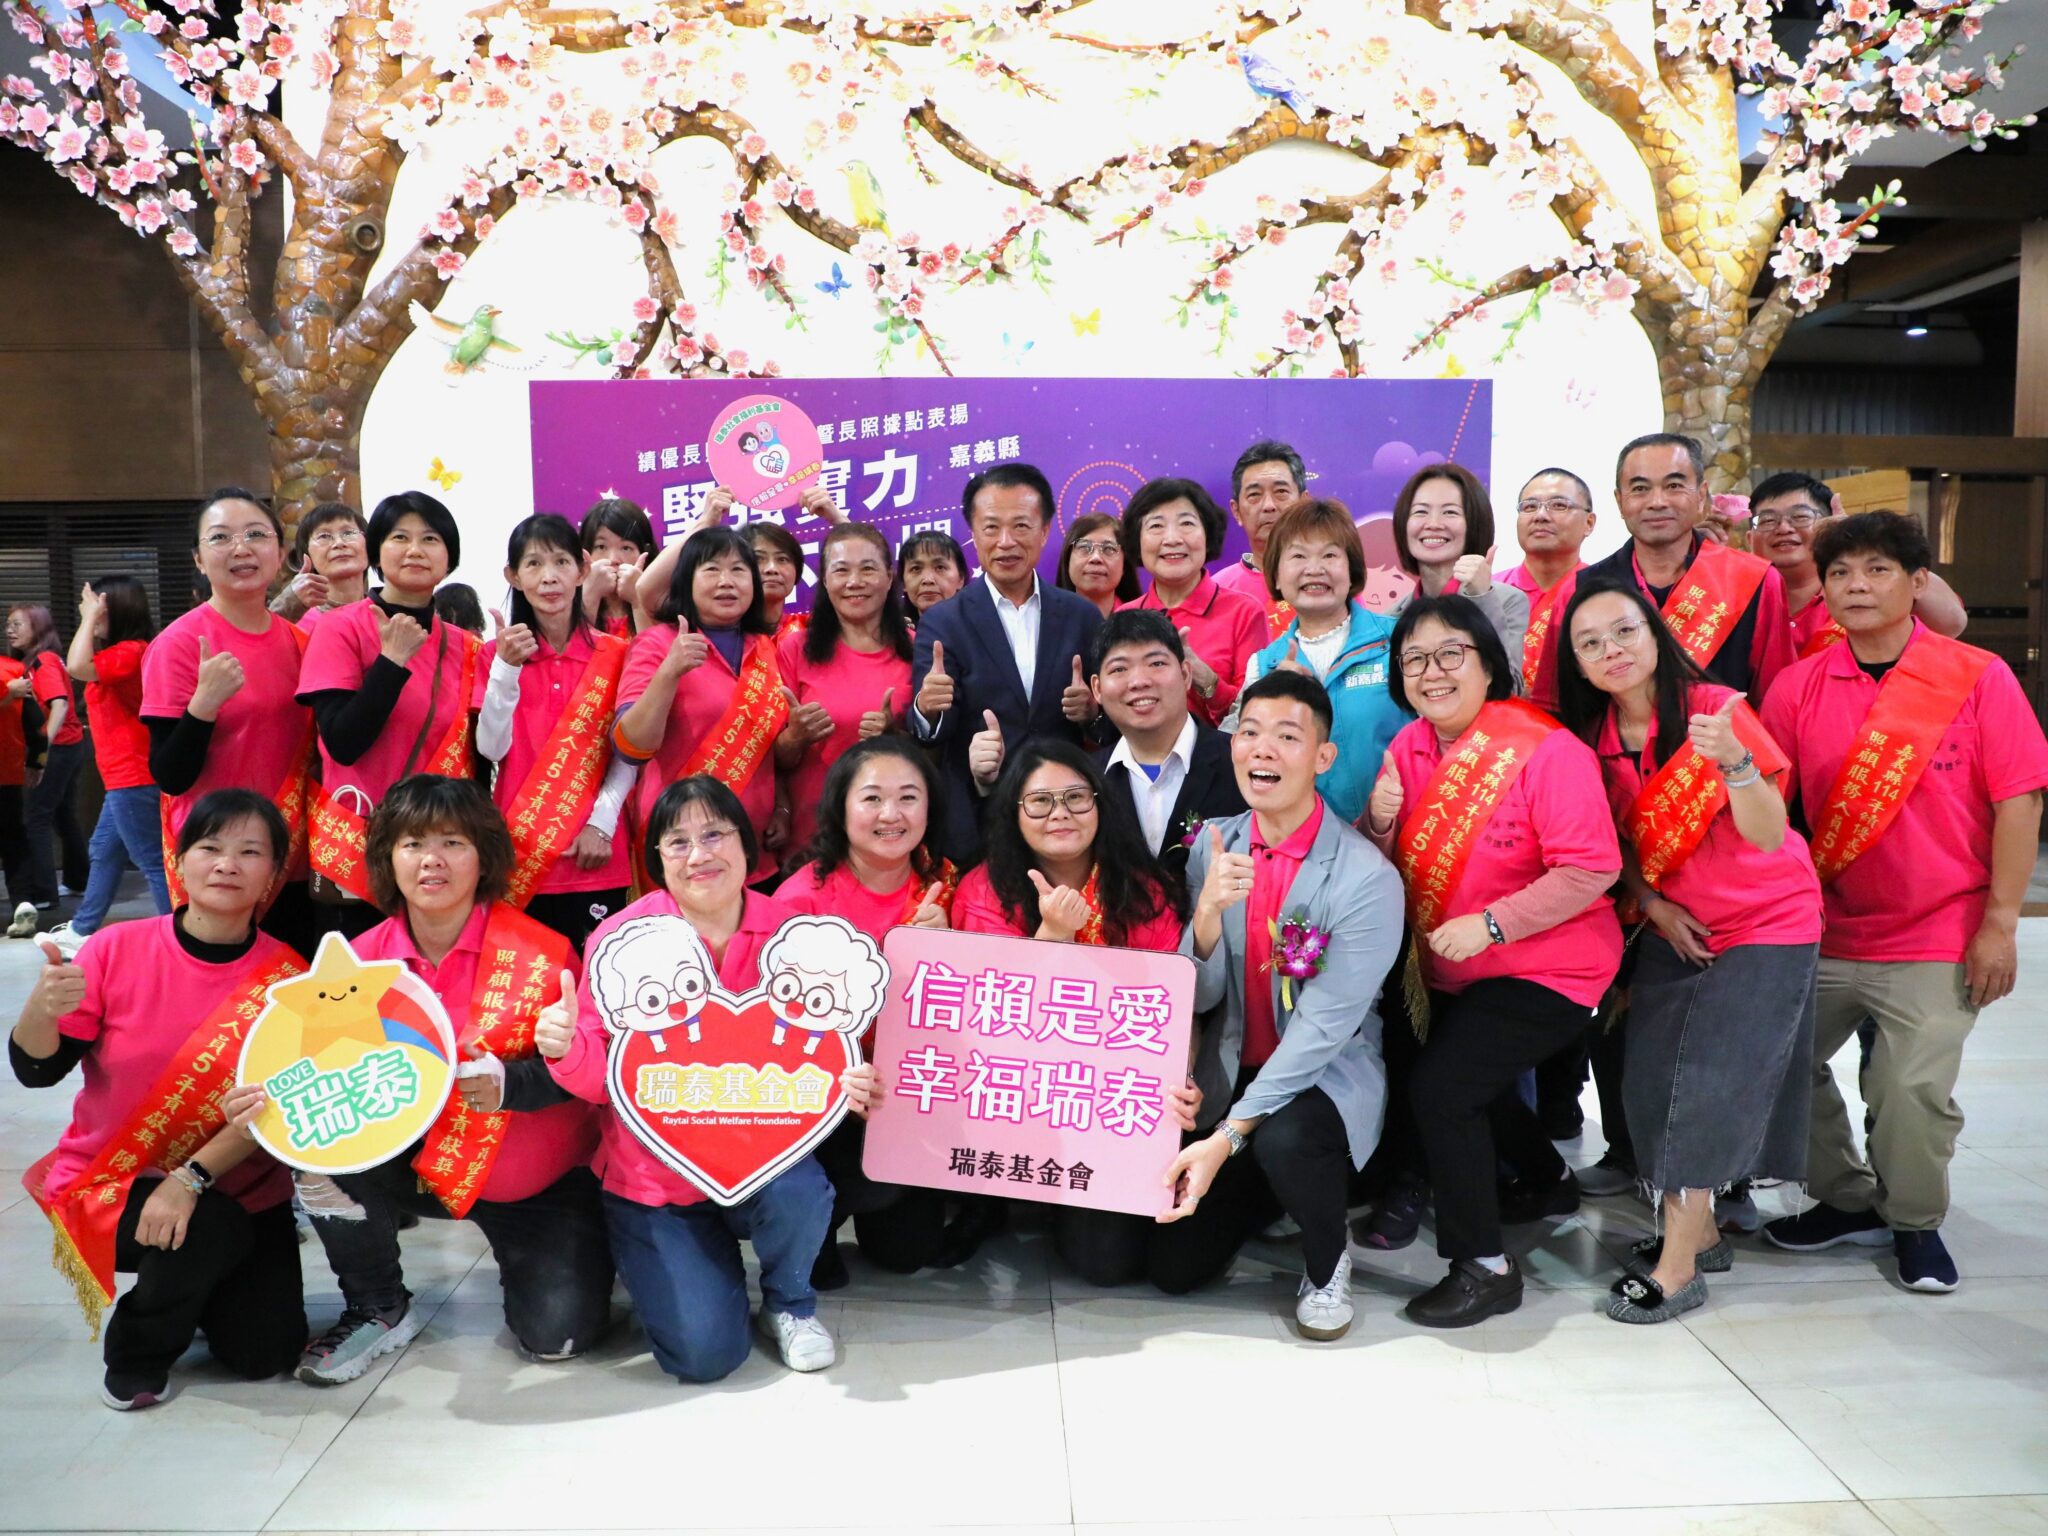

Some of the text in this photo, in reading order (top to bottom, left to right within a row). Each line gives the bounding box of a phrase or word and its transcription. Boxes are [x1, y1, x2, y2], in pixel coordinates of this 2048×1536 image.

[949, 435, 1021, 469] 嘉義縣
[904, 961, 1171, 1054] 信賴是愛
[270, 1063, 313, 1093] LOVE
[286, 1050, 412, 1145] 瑞泰
[643, 1070, 825, 1106] 瑞泰基金會
[895, 1046, 1165, 1136] 幸福瑞泰
[662, 1116, 801, 1126] Raytai Social Welfare Foundation
[949, 1147, 1094, 1192] 瑞泰基金會
